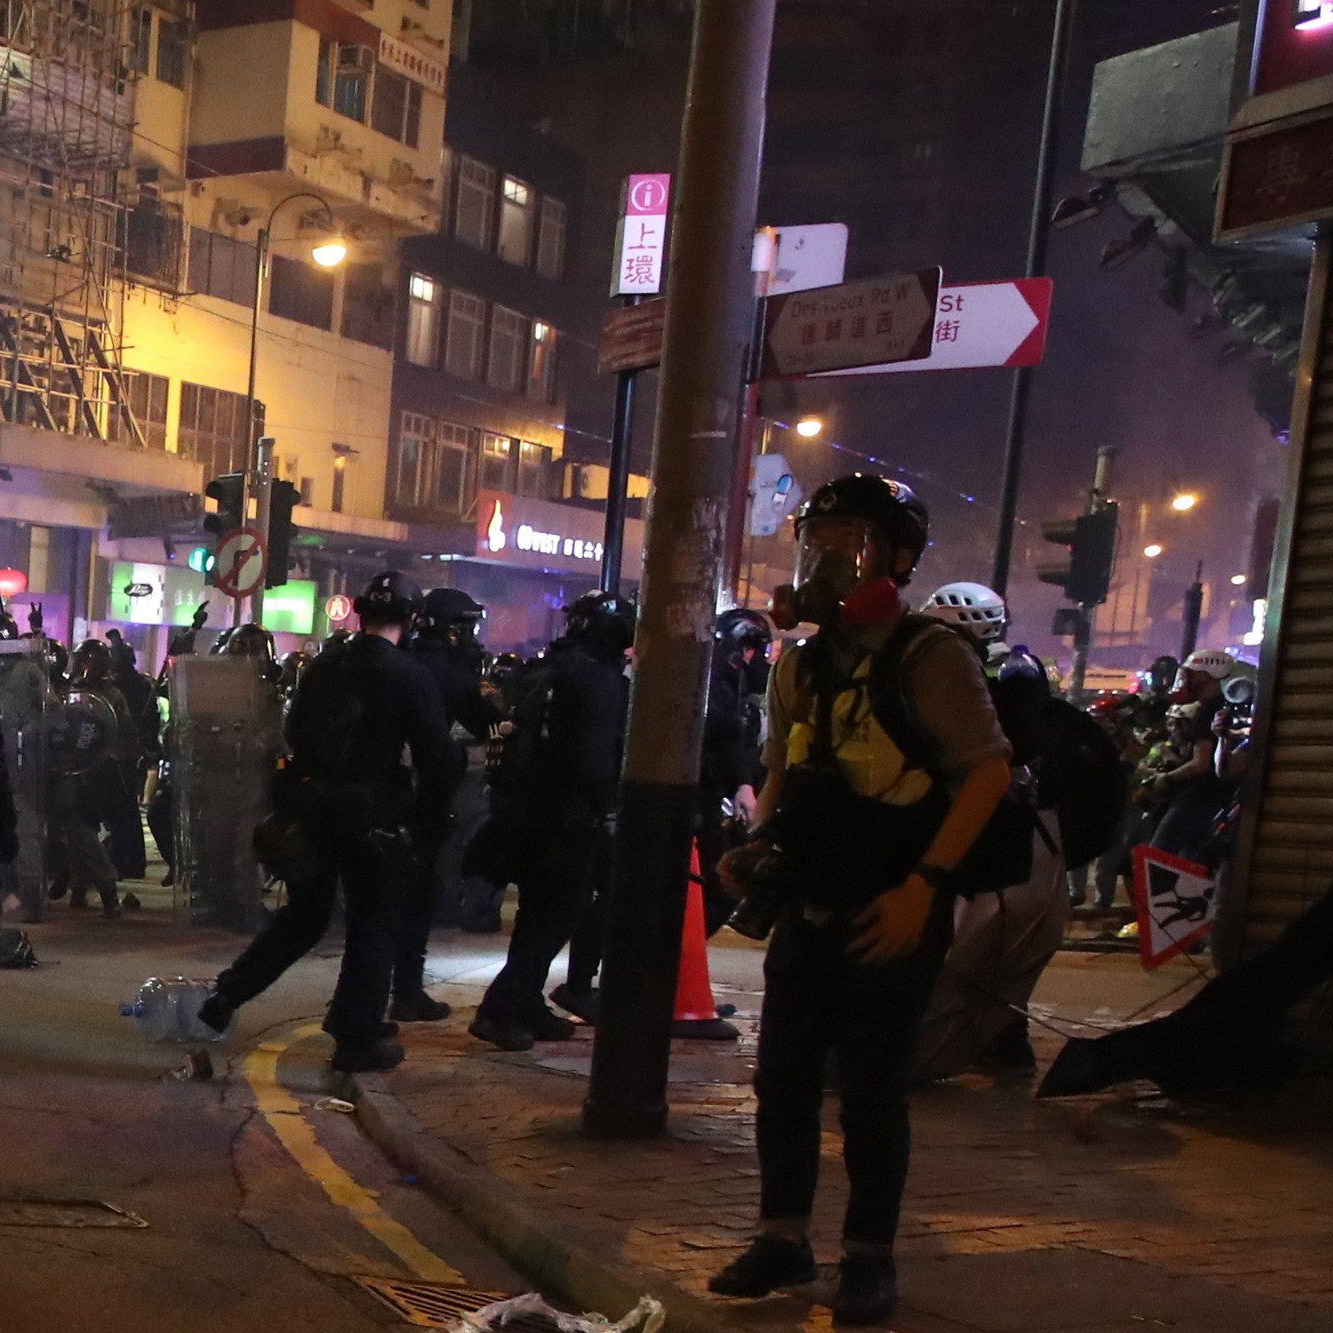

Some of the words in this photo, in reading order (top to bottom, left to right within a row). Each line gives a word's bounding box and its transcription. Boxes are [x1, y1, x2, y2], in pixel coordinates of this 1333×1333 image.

[624, 222, 657, 285] 上環
[939, 294, 964, 313] St
[935, 319, 961, 343] 街
